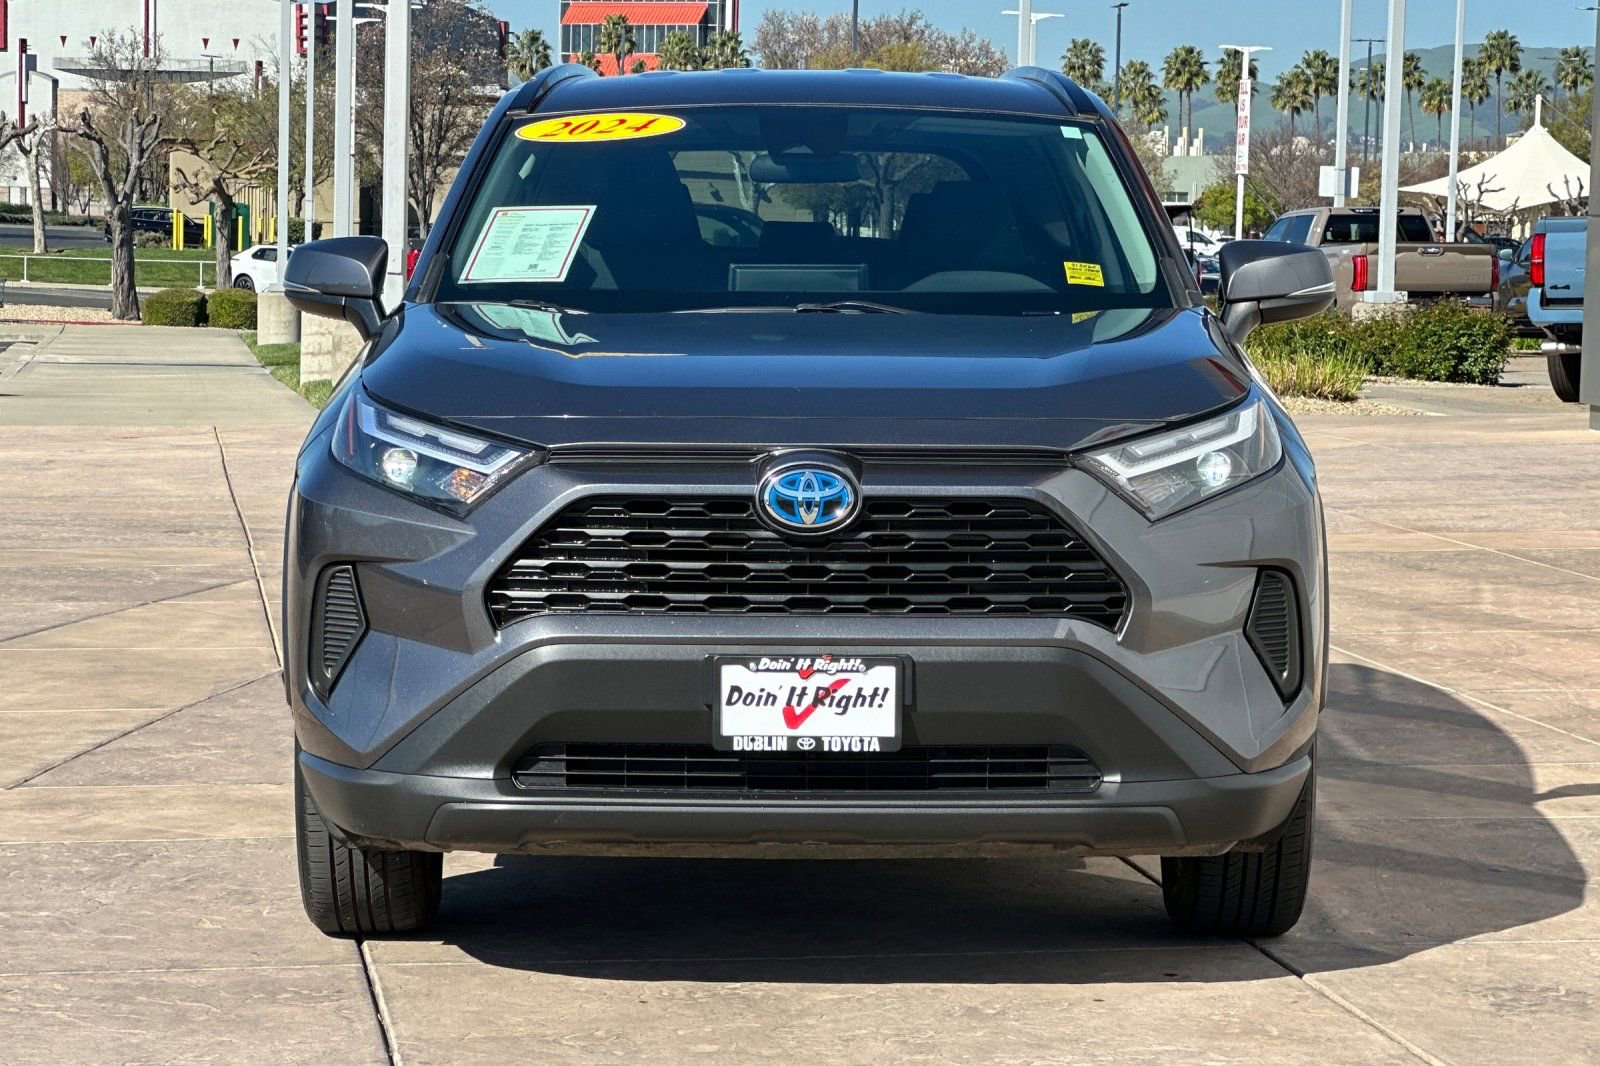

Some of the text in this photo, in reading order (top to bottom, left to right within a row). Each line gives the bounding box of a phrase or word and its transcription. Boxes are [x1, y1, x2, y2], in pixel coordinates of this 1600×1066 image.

[537, 117, 661, 138] 2024
[757, 657, 862, 675] Doin' It Right!
[725, 684, 890, 716] Doin' It Right!
[733, 736, 881, 752] DUBLIN TOYOTA
